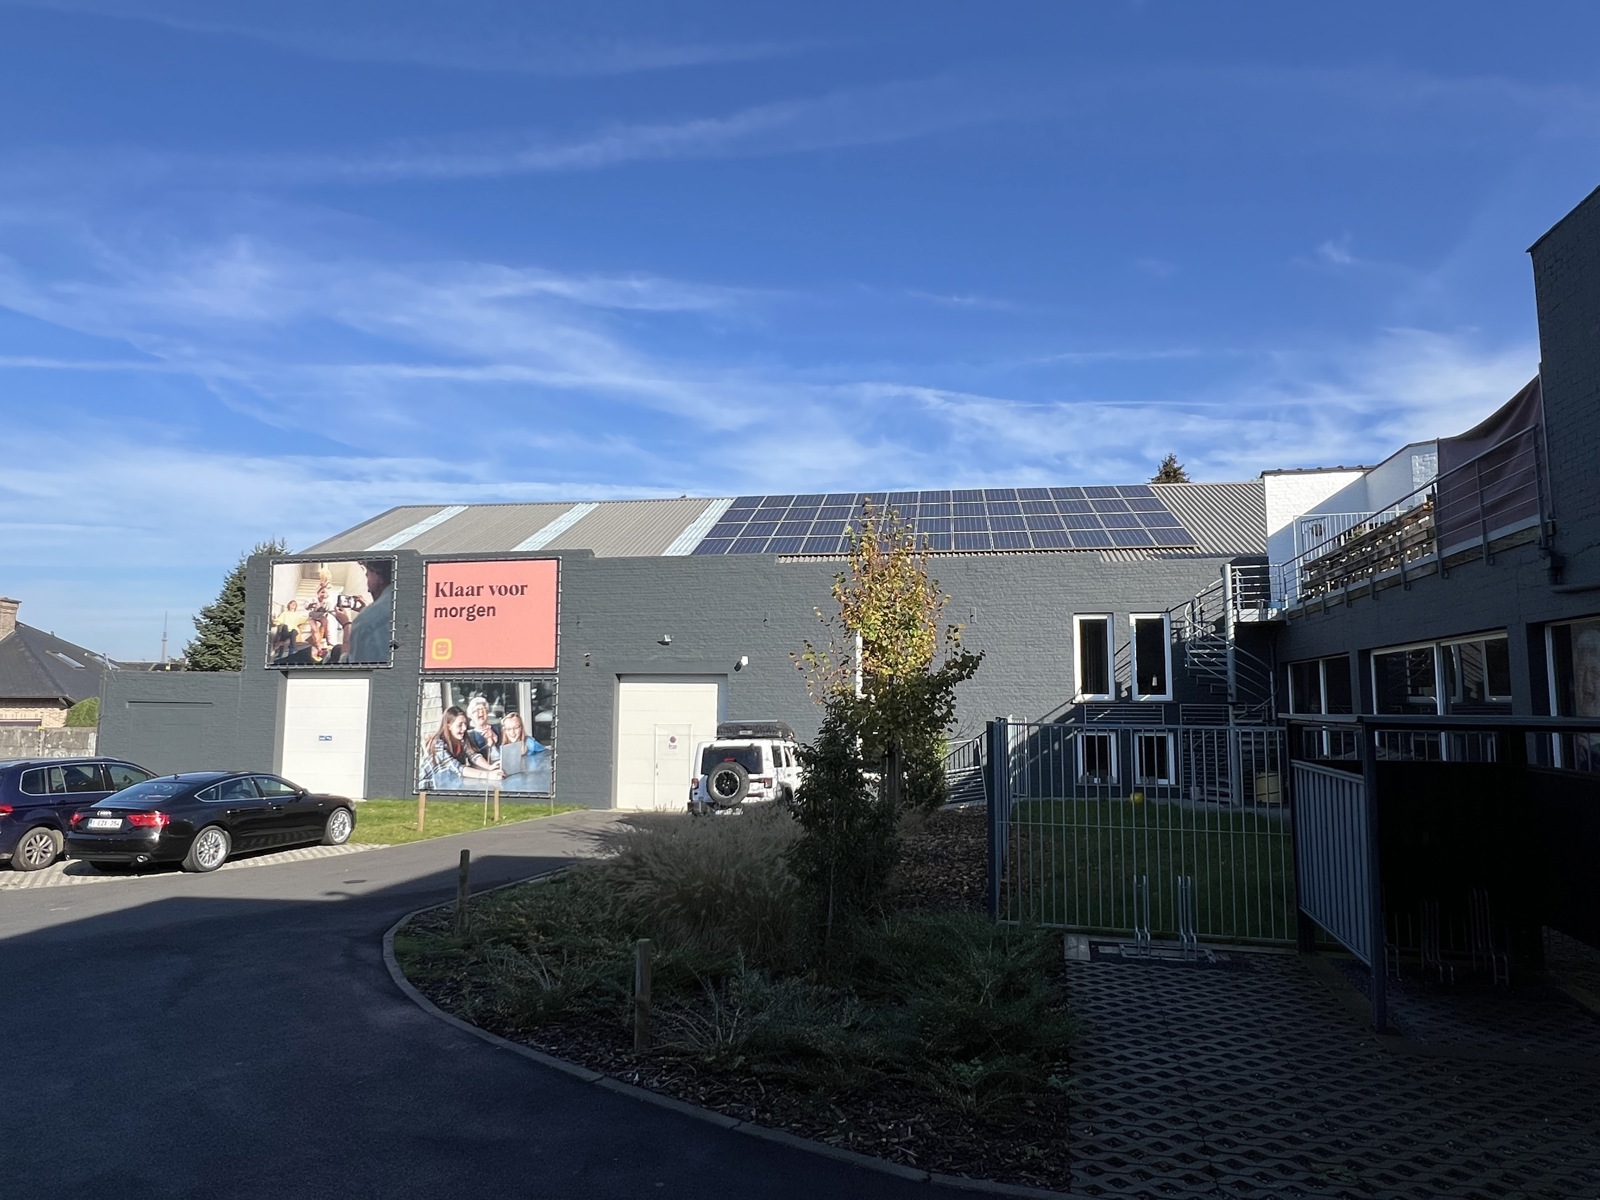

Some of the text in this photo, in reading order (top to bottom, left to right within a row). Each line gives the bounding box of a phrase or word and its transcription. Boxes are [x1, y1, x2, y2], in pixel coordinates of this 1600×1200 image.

[435, 582, 528, 597] Klaar voor
[434, 604, 496, 621] morgen
